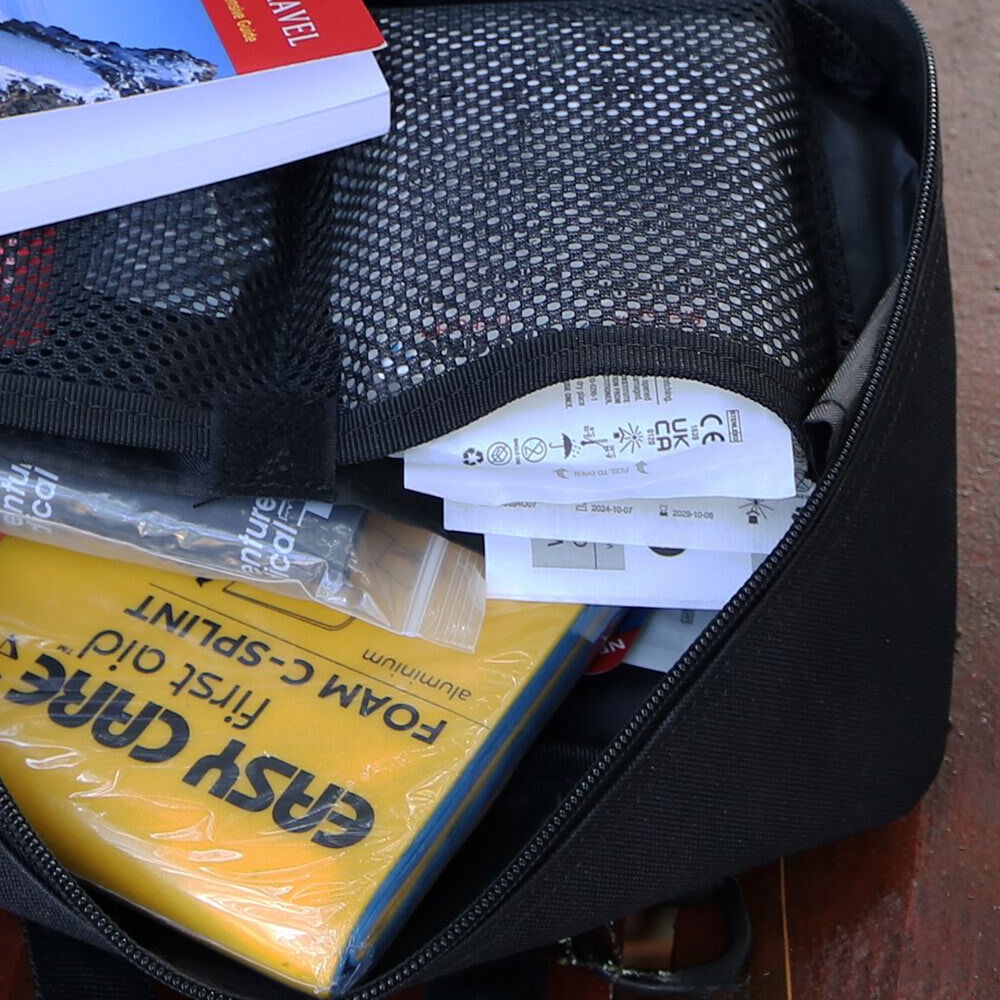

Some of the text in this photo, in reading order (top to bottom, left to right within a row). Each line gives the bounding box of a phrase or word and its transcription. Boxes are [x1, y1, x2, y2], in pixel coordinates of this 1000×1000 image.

[237, 18, 257, 43] Guide
[655, 420, 672, 452] CA
[672, 418, 690, 449] UK
[78, 629, 168, 675] aid
[122, 594, 449, 745] FOAM C-SPLINT
[361, 648, 473, 701] aluminium
[170, 663, 271, 731] first
[4, 654, 376, 850] EASY CARE
